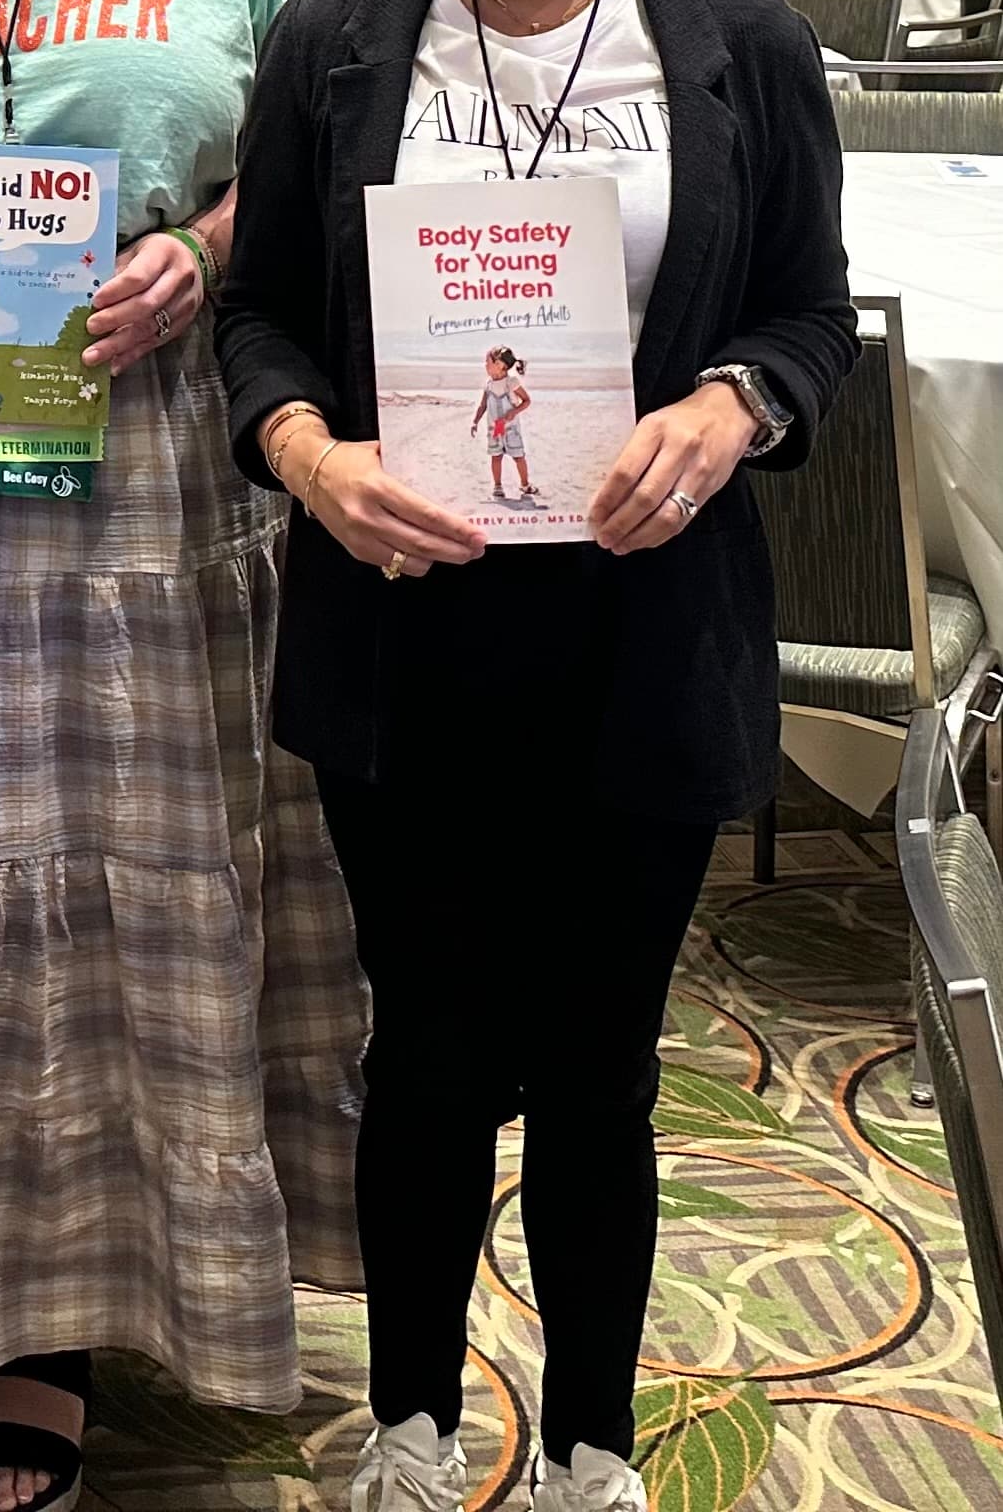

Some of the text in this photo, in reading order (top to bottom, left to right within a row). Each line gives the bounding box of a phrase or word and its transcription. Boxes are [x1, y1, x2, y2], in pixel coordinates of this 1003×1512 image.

[30, 169, 91, 201] NO!
[8, 208, 67, 236] Hugs
[418, 222, 571, 251] Body Safety
[435, 253, 557, 276] for Young
[443, 278, 553, 300] Children
[428, 305, 571, 335] Empowering Caring Adults
[3, 470, 23, 483] Bee
